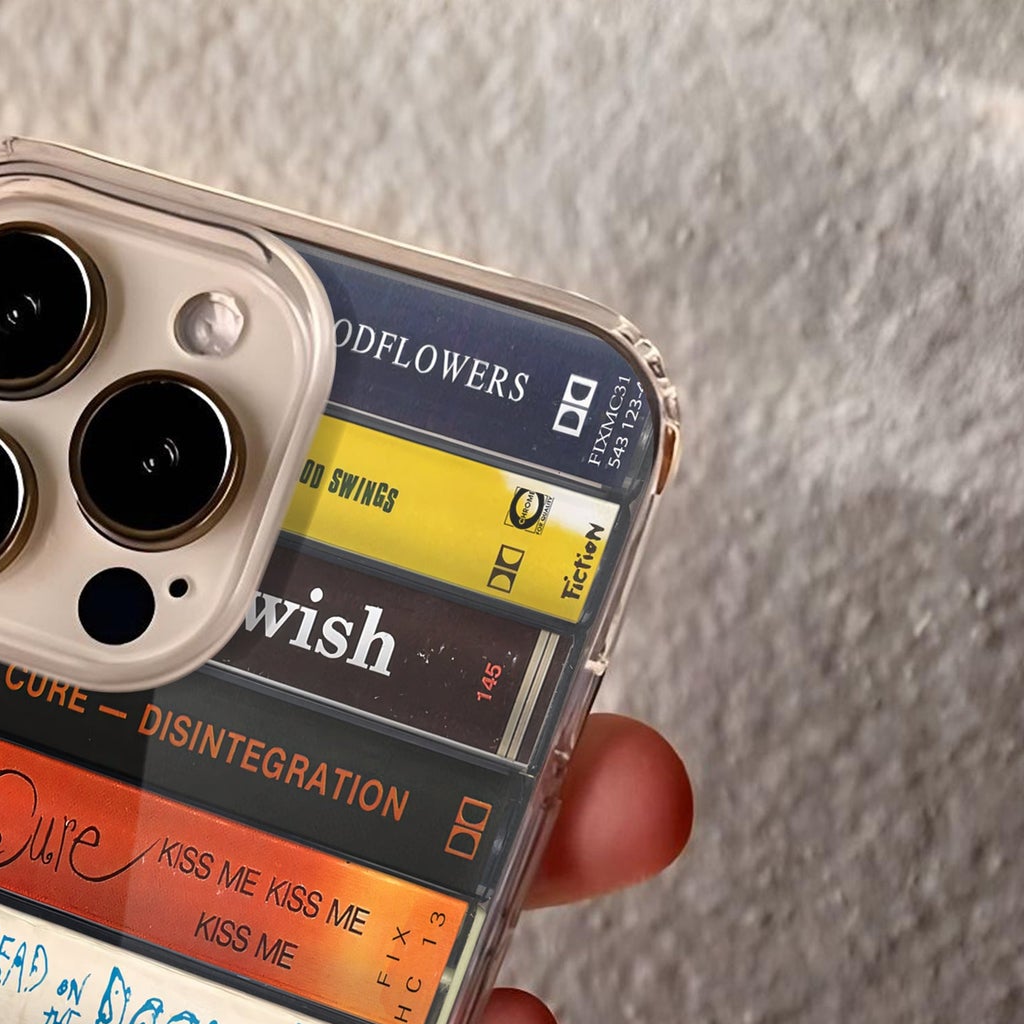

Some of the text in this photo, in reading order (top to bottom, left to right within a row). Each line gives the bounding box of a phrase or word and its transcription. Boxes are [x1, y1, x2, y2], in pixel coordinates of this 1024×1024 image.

[334, 318, 530, 402] ODFLOWERS
[588, 376, 631, 467] FIXMC31
[608, 436, 629, 469] 543
[328, 468, 399, 513] SWINGS
[519, 490, 536, 525] CHROME
[244, 587, 395, 676] wish
[477, 662, 502, 700] 145
[5, 663, 88, 713] CURE
[138, 703, 410, 821] DISINTEGRATION
[157, 837, 215, 880] KISS
[217, 860, 261, 896] ME
[266, 876, 322, 919] KISS
[325, 899, 371, 935] ME
[194, 911, 298, 970] KISS ME
